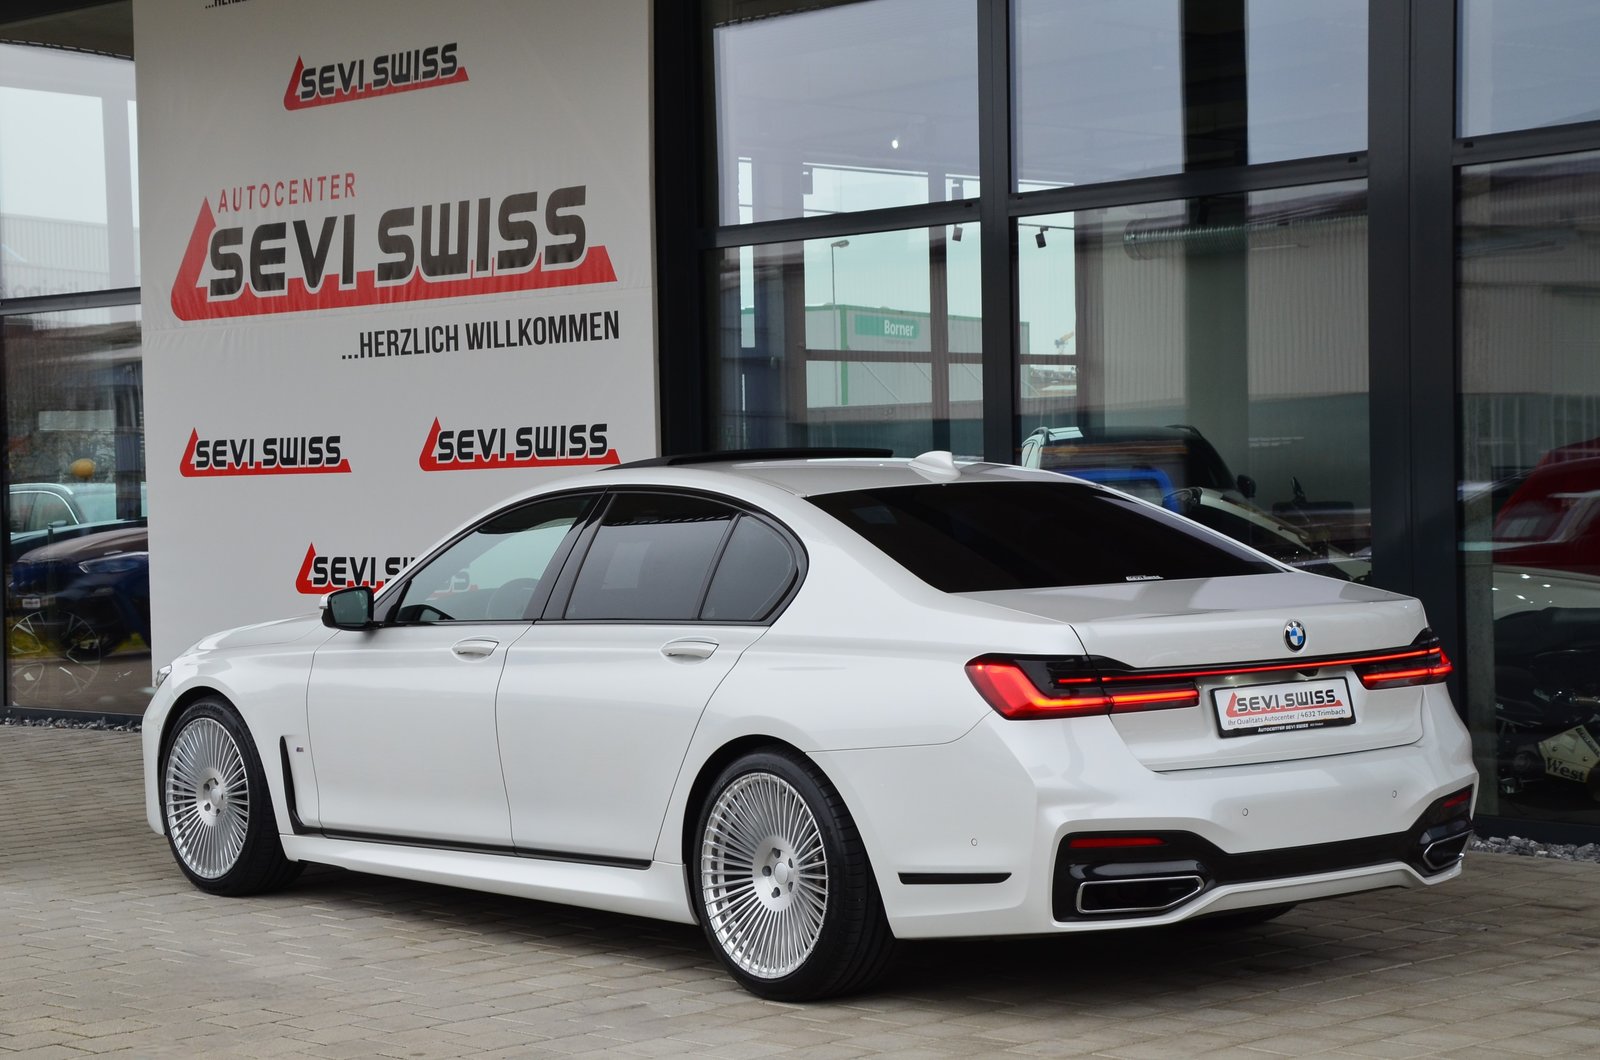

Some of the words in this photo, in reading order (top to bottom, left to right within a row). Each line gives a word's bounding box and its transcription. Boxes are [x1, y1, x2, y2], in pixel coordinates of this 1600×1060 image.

[301, 58, 365, 100] SEVI
[372, 42, 458, 88] SWISS
[219, 172, 355, 212] AUTOCENTER
[210, 214, 355, 297] SEVI
[377, 185, 586, 282] SWISS
[465, 310, 620, 351] WILLKOMMEN
[884, 319, 914, 337] Borner
[195, 438, 255, 468] SEVI
[262, 435, 341, 467] SWISS
[437, 427, 506, 462] SEVI
[515, 423, 608, 458] SWISS
[313, 556, 376, 586] SEVI
[1236, 694, 1280, 713] SEVI
[1284, 688, 1336, 708] SWISS
[1264, 713, 1296, 722] Autocenter
[1301, 711, 1316, 719] 4632
[1317, 709, 1346, 717] Trimbach
[1546, 757, 1585, 781] West
